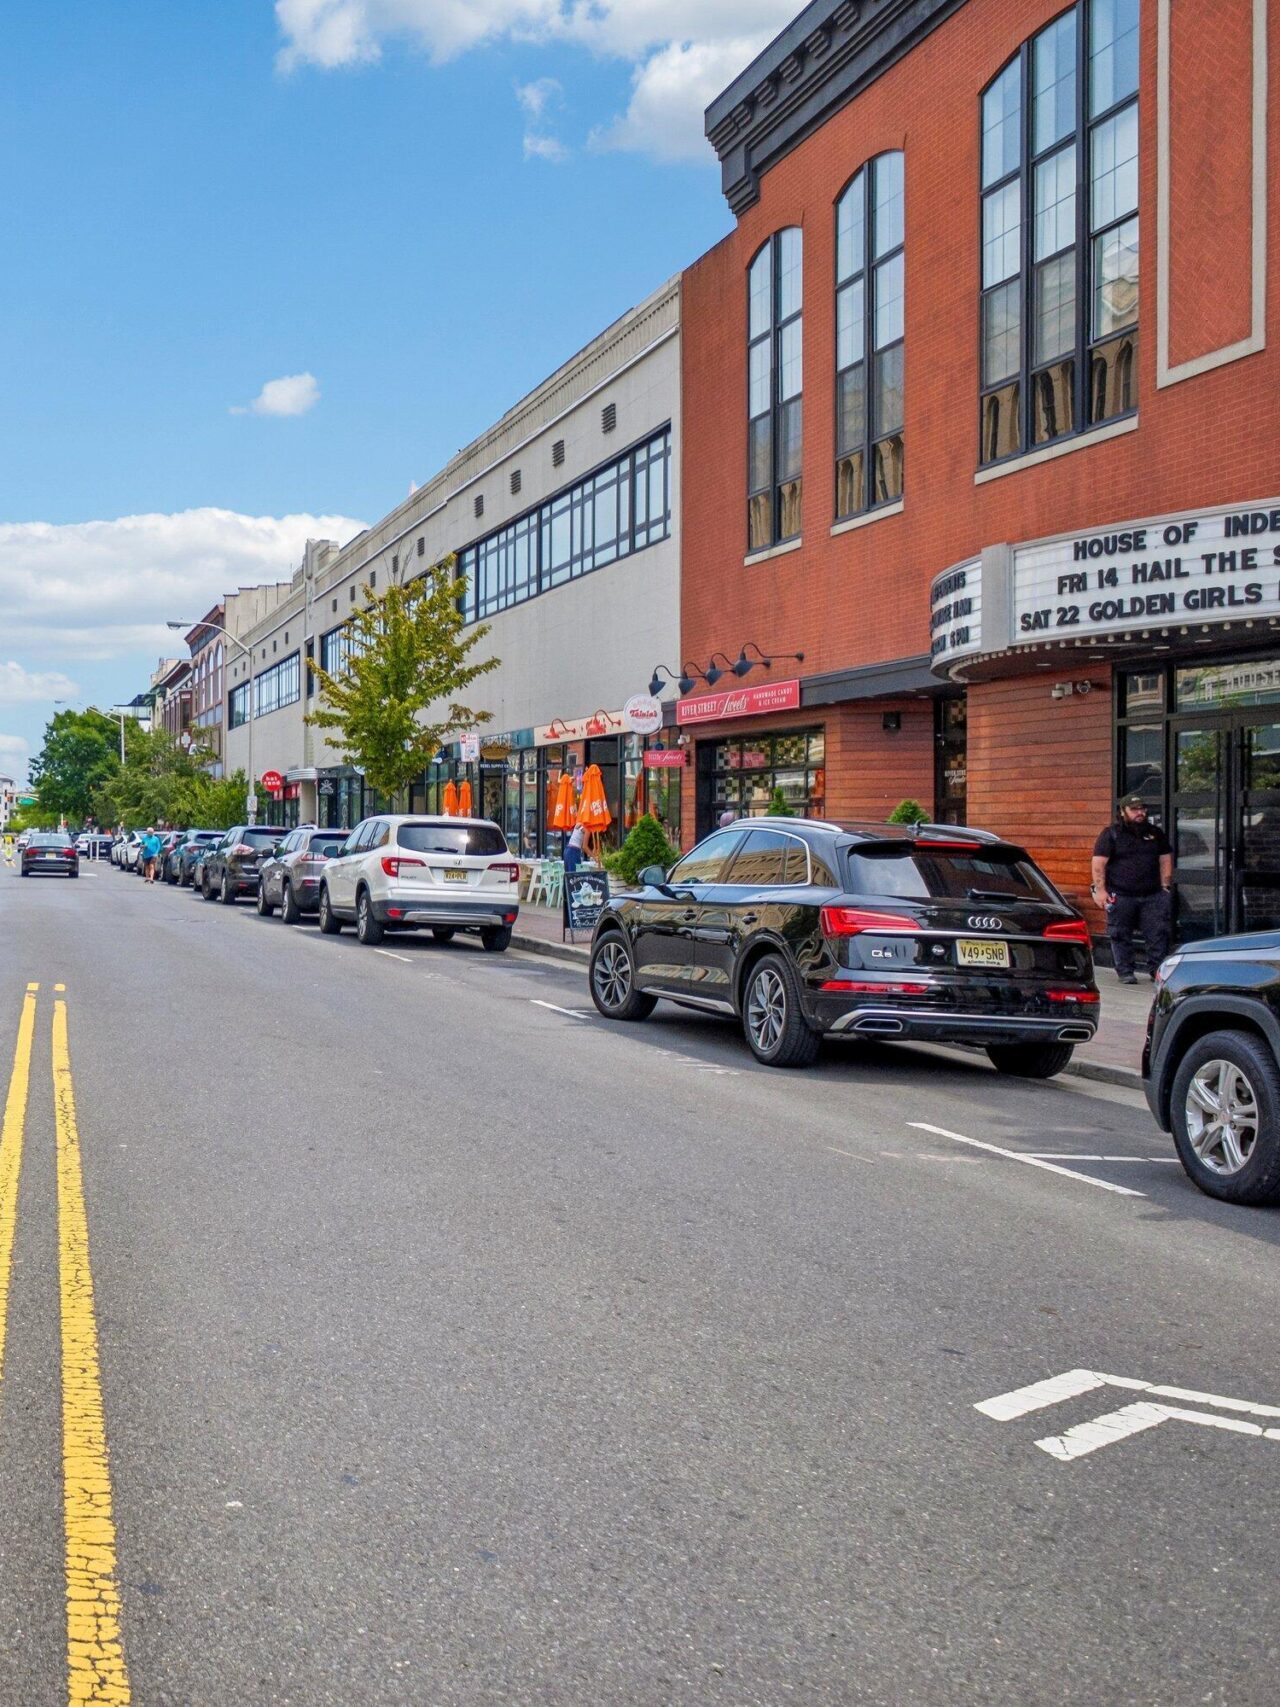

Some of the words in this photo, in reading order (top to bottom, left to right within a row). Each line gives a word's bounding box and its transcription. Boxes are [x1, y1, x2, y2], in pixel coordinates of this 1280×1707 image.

[1073, 529, 1147, 561] HOUSE
[1163, 521, 1199, 546] OF
[1057, 572, 1088, 595] FRI
[1097, 567, 1118, 589] 14
[1132, 557, 1190, 584] HAIL
[1201, 547, 1258, 575] THE
[1020, 609, 1052, 632] SAT
[1056, 605, 1080, 627] 22
[1088, 592, 1175, 621] GOLDEN
[1183, 583, 1263, 610] GIRLS
[681, 705, 697, 717] RIVER
[697, 701, 717, 714] STREET
[718, 694, 747, 718] Sweets
